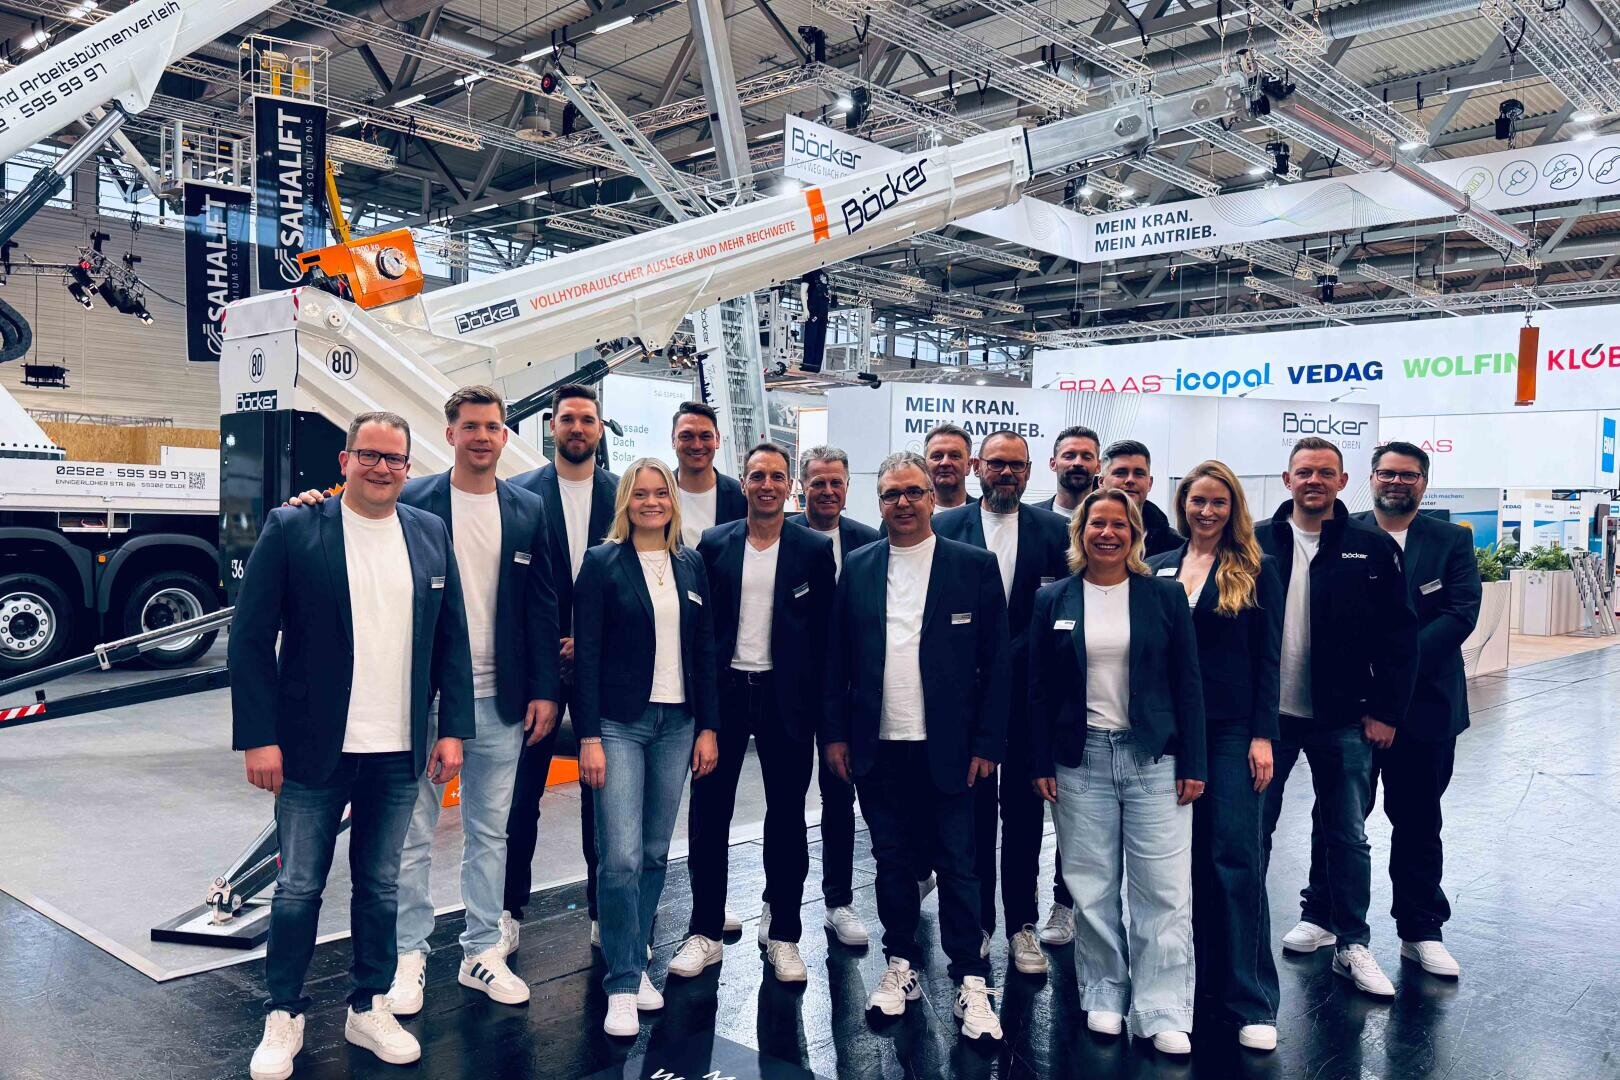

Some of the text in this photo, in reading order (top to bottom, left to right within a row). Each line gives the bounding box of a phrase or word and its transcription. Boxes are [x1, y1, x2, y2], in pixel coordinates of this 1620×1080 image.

[20, 0, 181, 96] Arbeitsbühnenverleih
[19, 62, 108, 118] 595 99 97
[305, 118, 315, 188] SOLUTIONS
[792, 127, 862, 170] Böcker
[277, 107, 305, 248] SAHALIFT
[841, 158, 928, 235] Böcker
[813, 214, 825, 224] NEU
[1095, 209, 1193, 235] MEIN KRAN.
[229, 203, 239, 267] SOLUTIONS
[1094, 225, 1217, 253] MEIN ANTRIEB.
[529, 220, 796, 310] VOLLHYDRAULISCHER AUSLEGER UND MEHR REICHWEITE
[456, 304, 517, 333] Böcker
[252, 353, 263, 377] 80
[332, 350, 352, 375] 80
[1176, 362, 1271, 395] icopal
[1287, 361, 1383, 385] VEDAG
[236, 391, 277, 412] Böcker
[905, 396, 1020, 416] MEIN KRAN.
[619, 423, 649, 434] ssade
[905, 418, 1045, 438] ME ANTRIEB.
[1283, 412, 1368, 436] Böcker
[612, 436, 635, 448] Dach
[612, 451, 636, 462] Solar
[56, 465, 187, 480] 02522 595 99 97
[1341, 552, 1368, 560] Böcker
